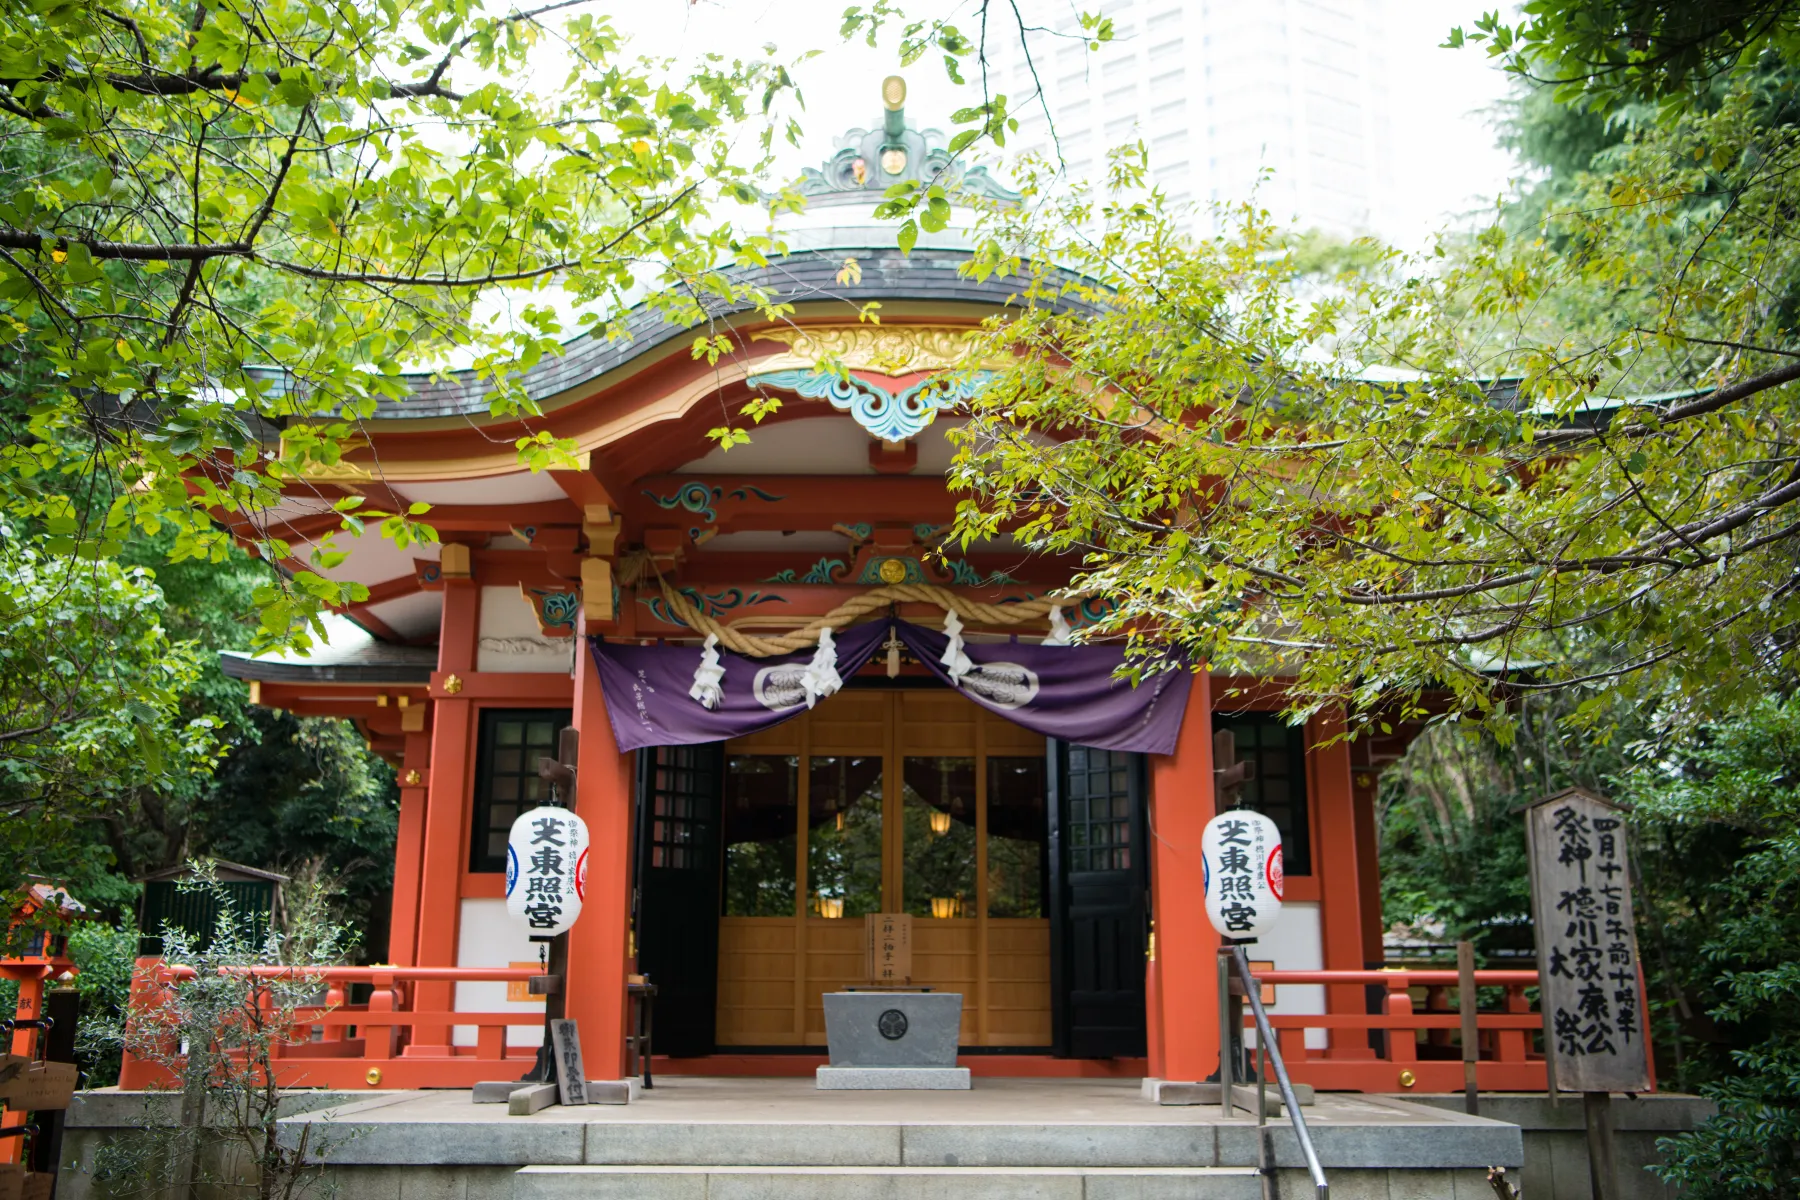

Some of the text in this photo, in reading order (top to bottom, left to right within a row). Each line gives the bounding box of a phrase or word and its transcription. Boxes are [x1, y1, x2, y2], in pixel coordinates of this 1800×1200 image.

[524, 817, 566, 929] 芝東照宮
[1217, 820, 1257, 932] 芝東照宮
[1593, 818, 1637, 1045] 四月十七日午前十時半
